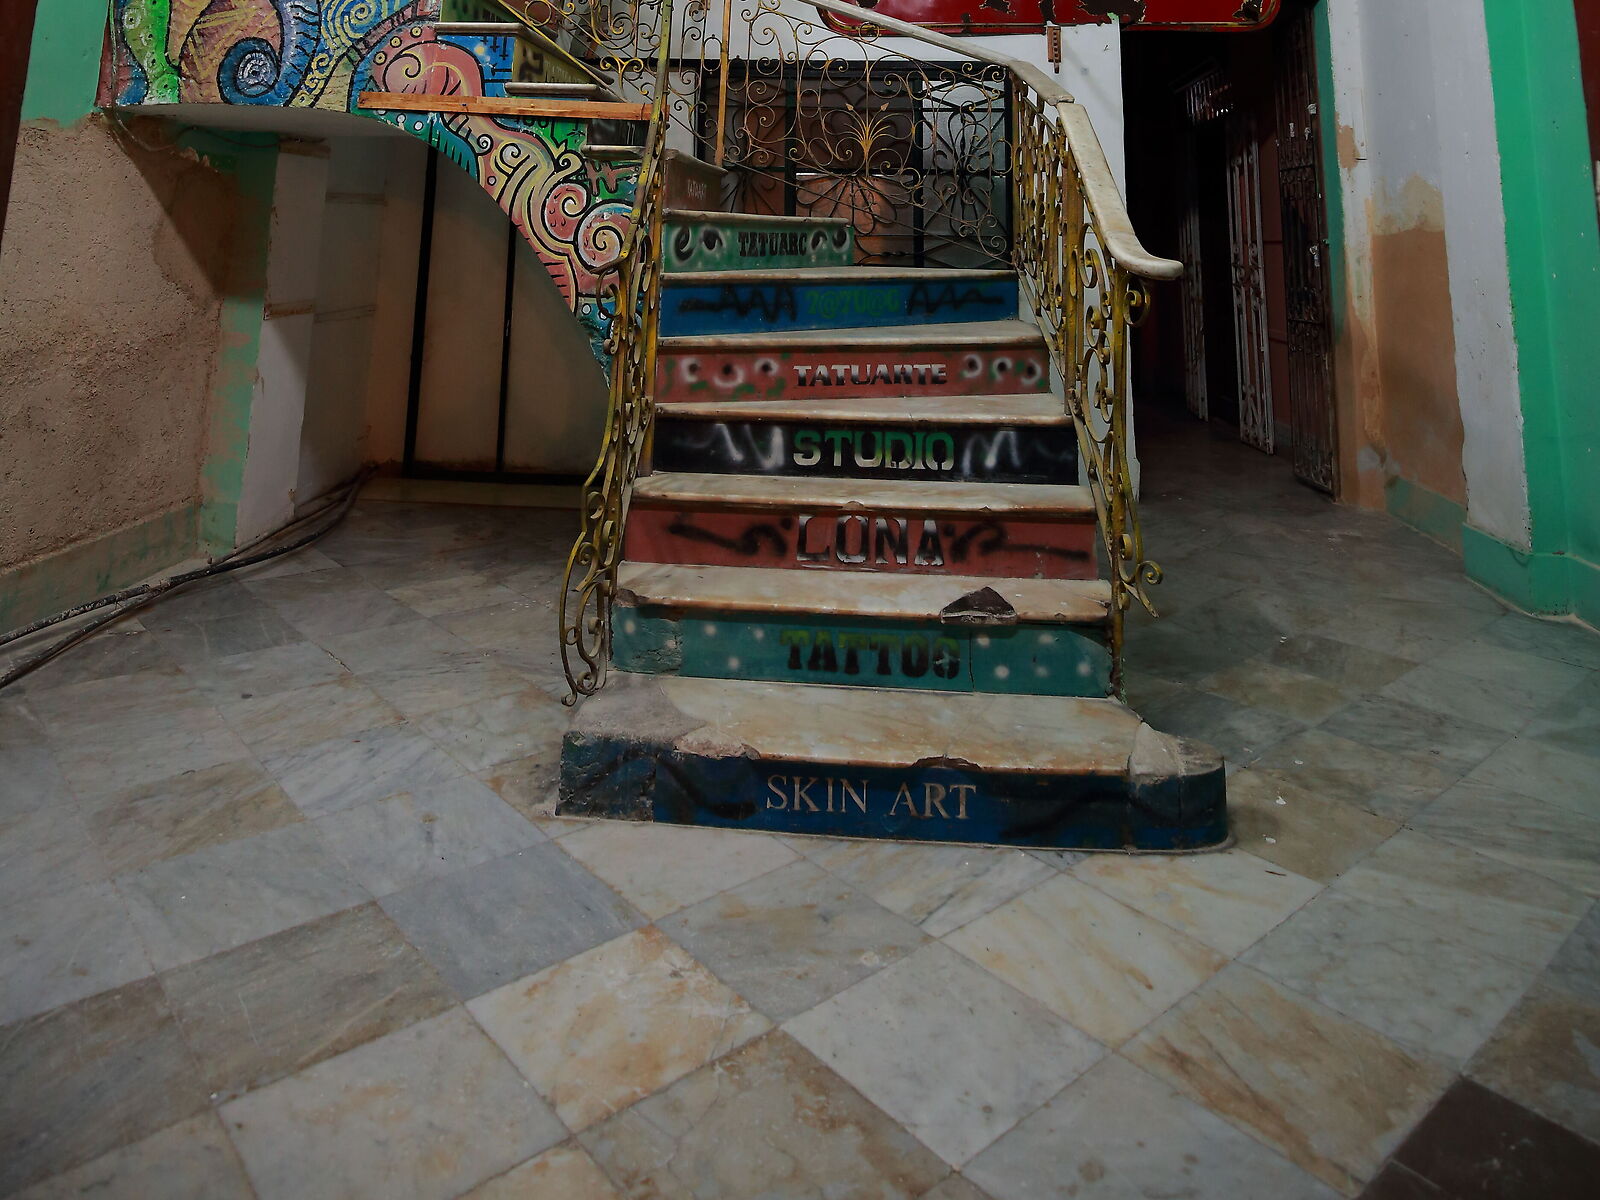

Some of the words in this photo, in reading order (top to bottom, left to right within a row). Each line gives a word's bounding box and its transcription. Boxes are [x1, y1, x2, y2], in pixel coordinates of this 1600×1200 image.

[793, 363, 947, 386] TATUARTE
[792, 429, 955, 471] STUDIO
[796, 513, 945, 567] LONA
[780, 628, 961, 680] TATTOO
[766, 774, 869, 814] SKIN
[889, 781, 977, 819] ART
